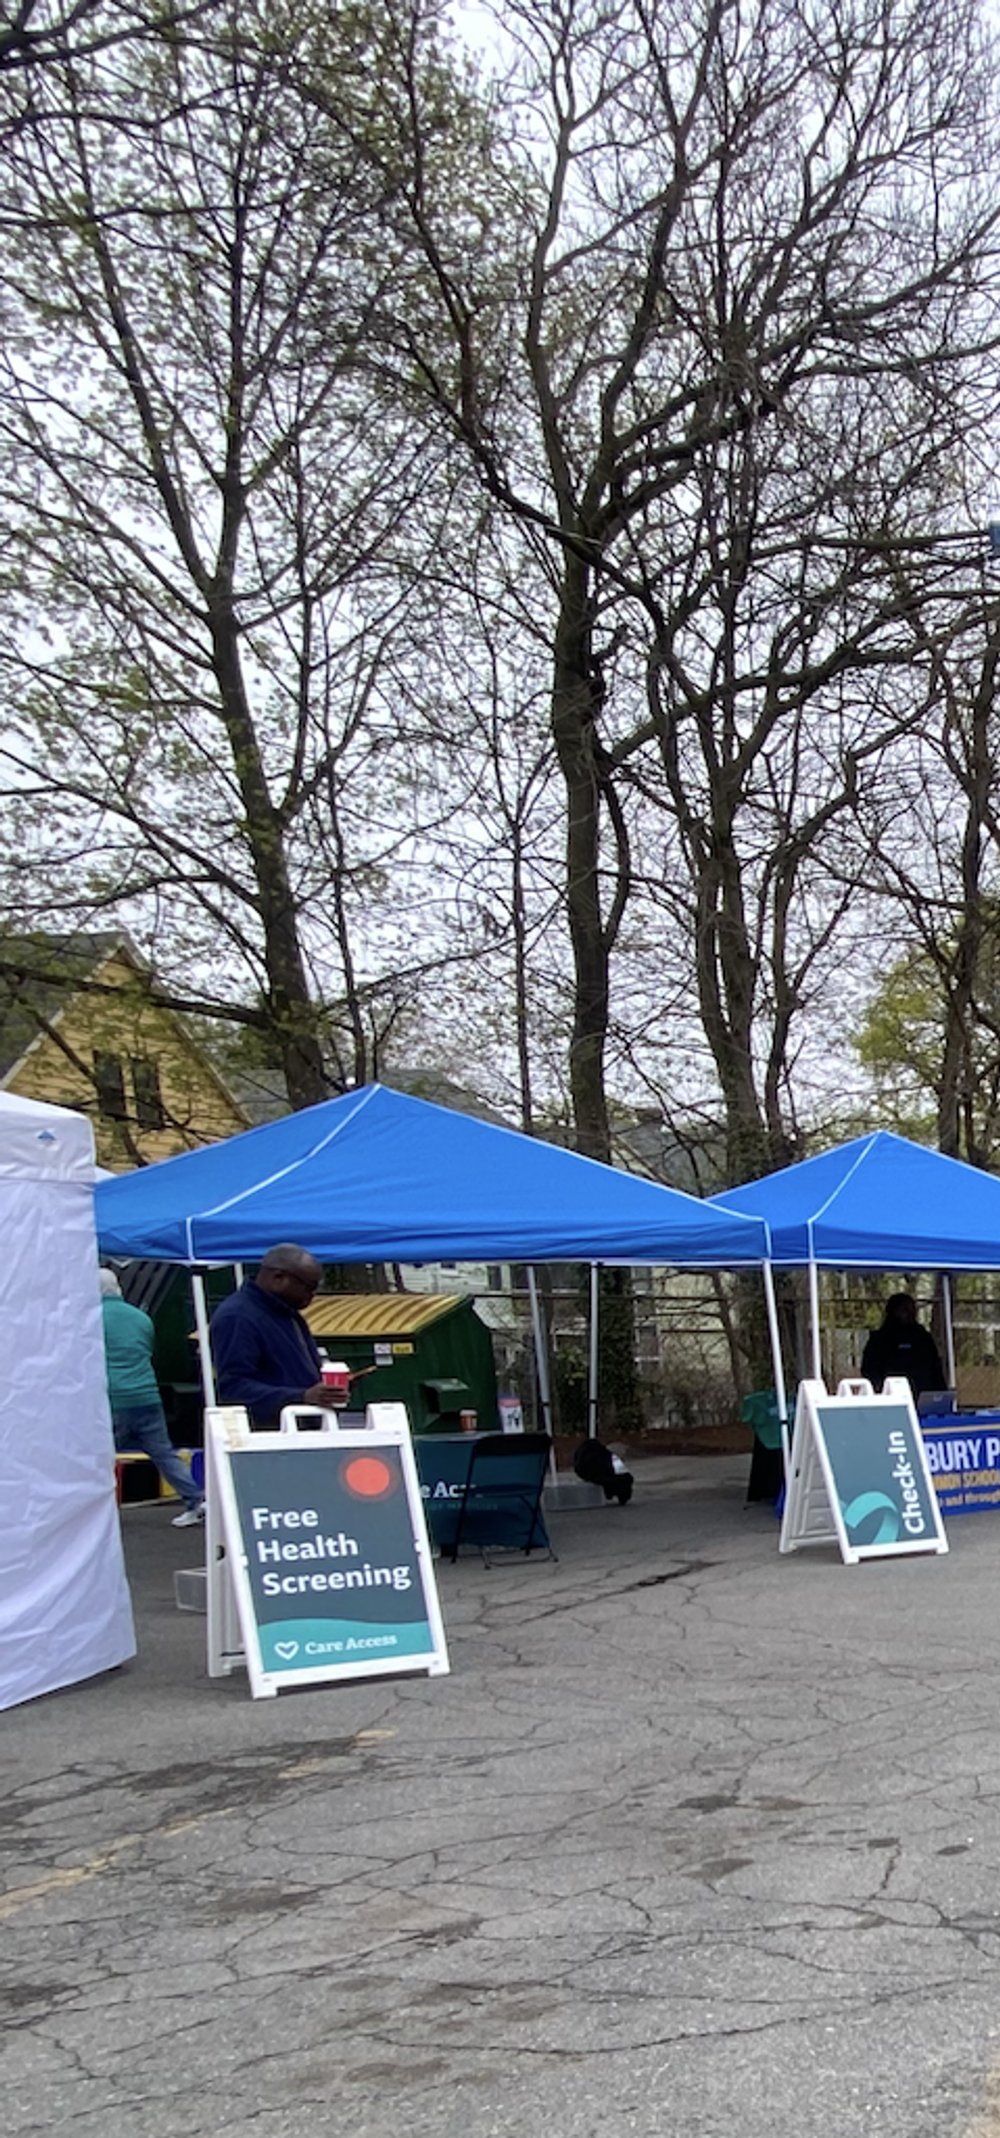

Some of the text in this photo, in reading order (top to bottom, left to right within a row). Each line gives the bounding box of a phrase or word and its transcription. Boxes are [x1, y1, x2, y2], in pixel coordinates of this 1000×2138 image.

[889, 1430, 924, 1533] Check-In
[252, 1507, 318, 1529] Free
[257, 1533, 358, 1562] Health
[263, 1564, 411, 1595] Screening
[304, 1634, 397, 1655] Care Access
